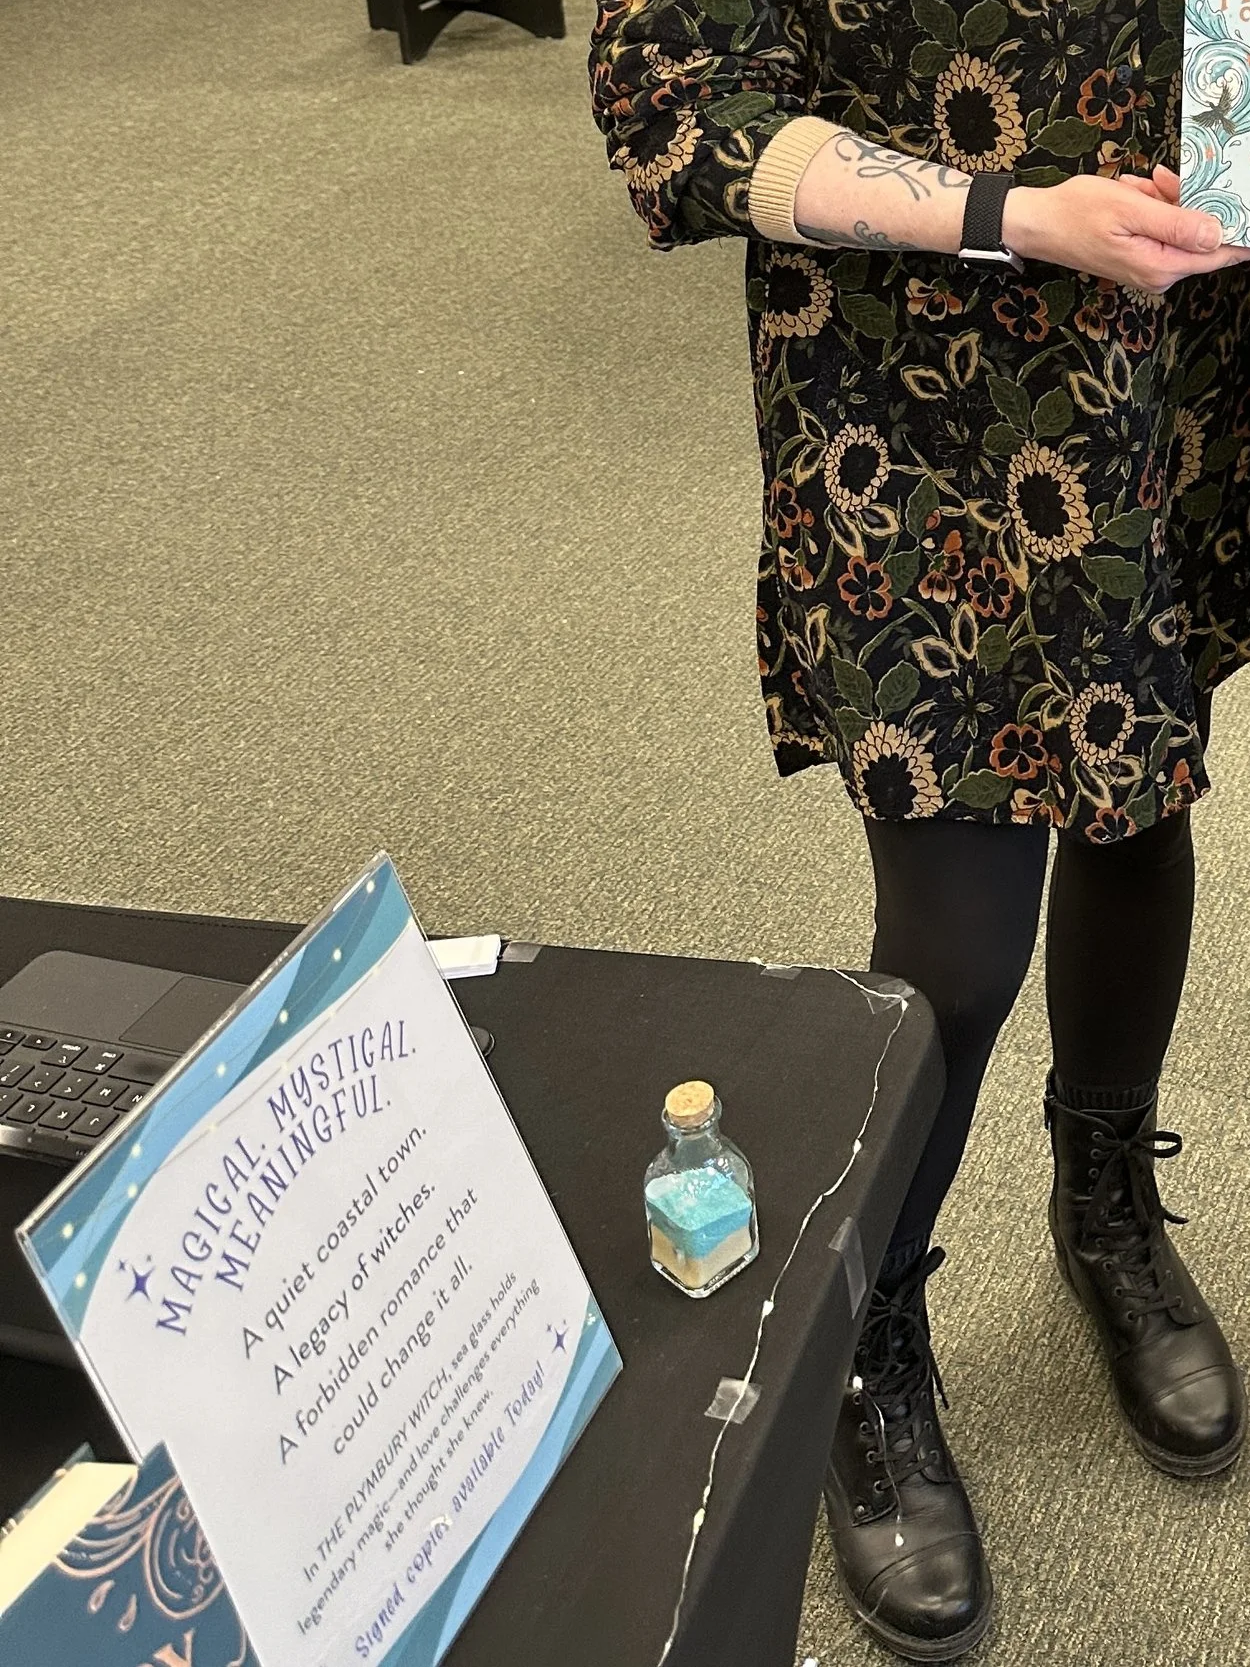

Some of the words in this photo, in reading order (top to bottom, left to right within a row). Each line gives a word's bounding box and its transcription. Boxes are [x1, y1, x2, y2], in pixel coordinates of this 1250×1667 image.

[155, 1136, 267, 1336] MAGICAL.
[266, 1020, 416, 1133] MYSTICAL.
[214, 1074, 391, 1292] MEANINGFUL.
[242, 1326, 264, 1359] A
[264, 1261, 315, 1332] quiet
[316, 1173, 379, 1264] coastal
[378, 1126, 427, 1183] town.
[273, 1364, 293, 1395] A
[288, 1289, 350, 1368] legacy
[351, 1252, 370, 1291] of
[370, 1182, 436, 1264] witches.
[279, 1434, 299, 1465] A
[295, 1325, 379, 1436] forbidden
[379, 1232, 447, 1327] romance
[445, 1187, 478, 1234] that
[304, 1562, 320, 1584] In
[316, 1516, 347, 1562] THE
[344, 1421, 410, 1524] PLYMBURY
[407, 1366, 453, 1430] WITCH,
[451, 1345, 469, 1370] sea
[468, 1314, 493, 1350] glass
[490, 1271, 517, 1310] holds
[333, 1383, 379, 1456] could
[380, 1308, 436, 1390] change
[432, 1287, 450, 1311] it
[450, 1255, 473, 1291] all.
[297, 1550, 357, 1636] legendary
[416, 1428, 442, 1461] love
[440, 1349, 491, 1428] challenges
[490, 1277, 541, 1352] everything
[354, 1581, 406, 1659] Signed
[405, 1522, 451, 1584] copies
[451, 1426, 506, 1514] available
[502, 1360, 546, 1428] Today!
[384, 1521, 405, 1552] she
[403, 1456, 447, 1522] thought
[445, 1430, 465, 1459] she
[462, 1390, 494, 1432] knew.
